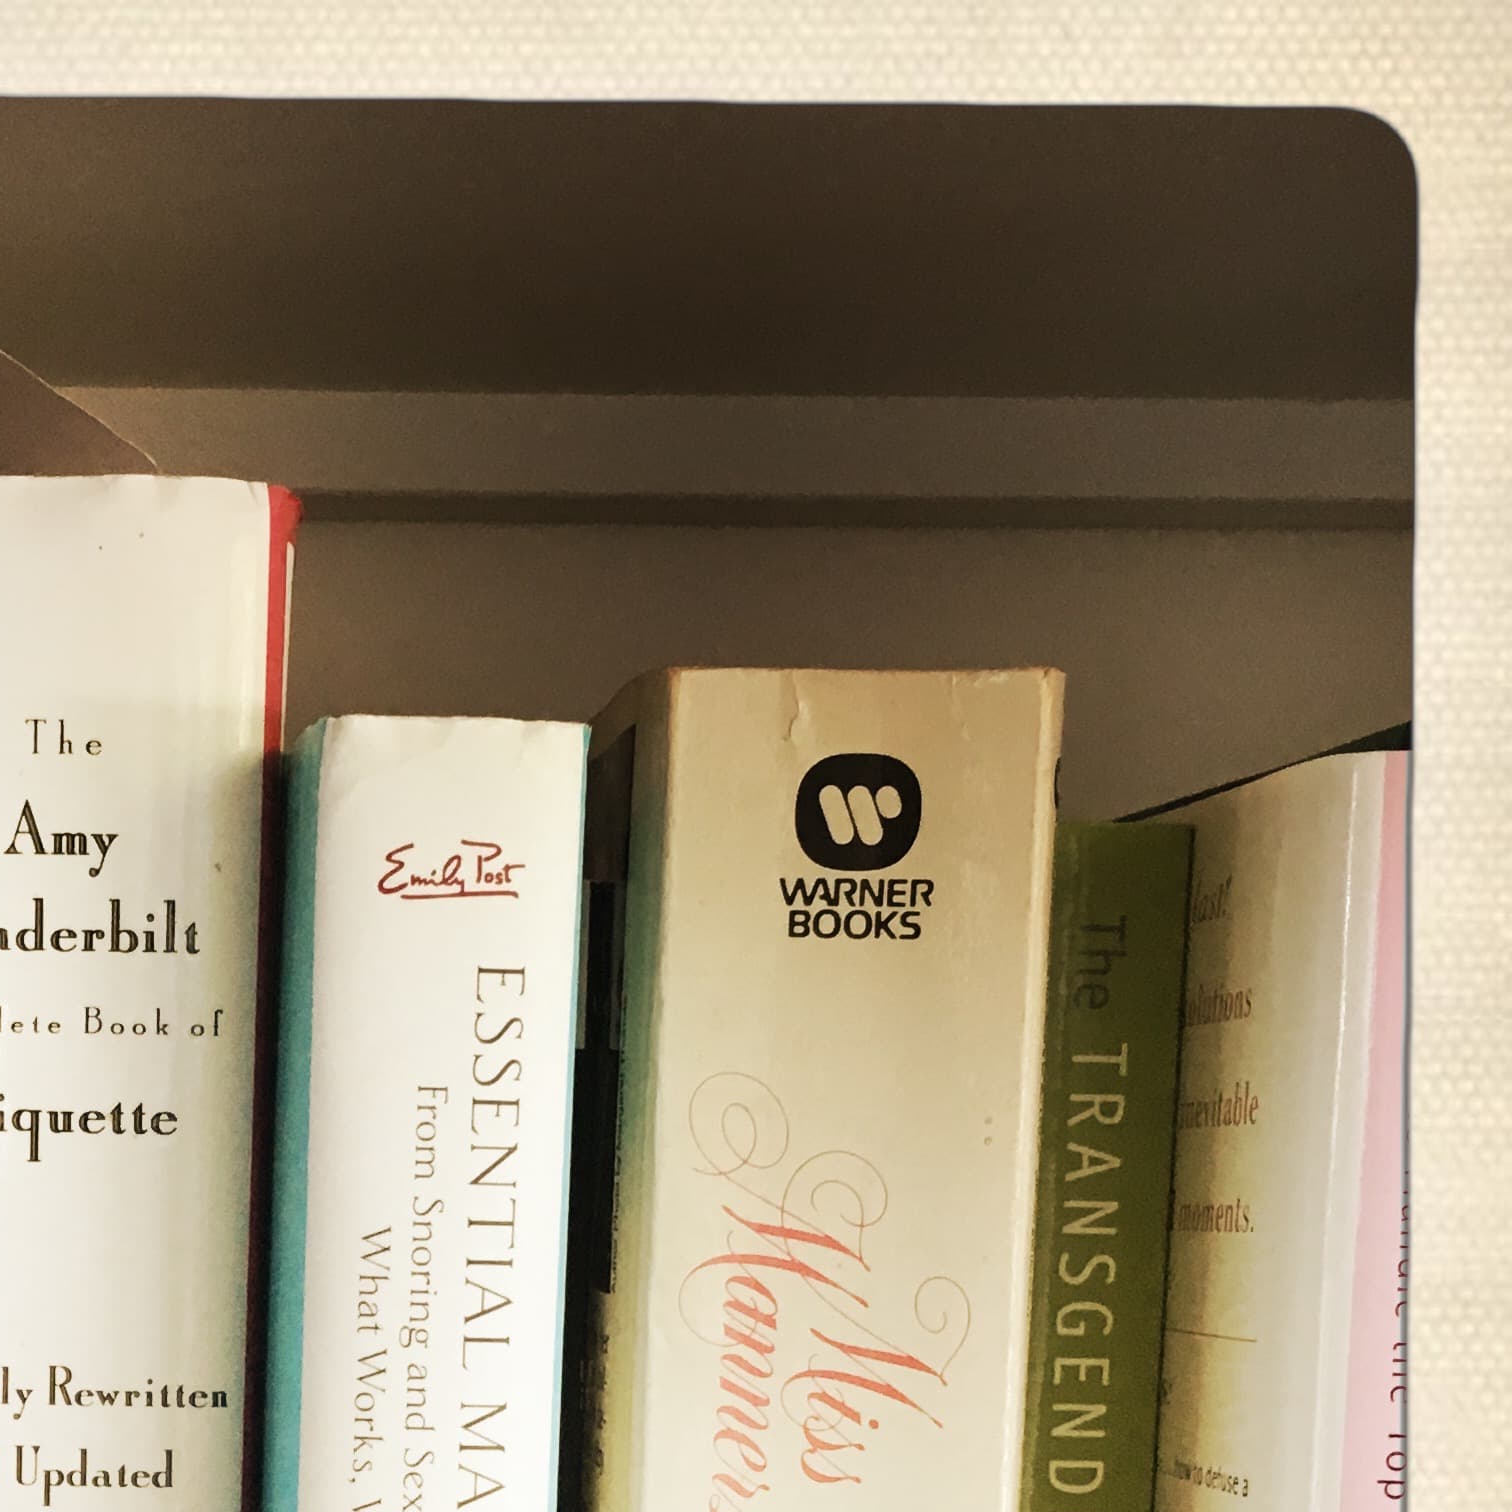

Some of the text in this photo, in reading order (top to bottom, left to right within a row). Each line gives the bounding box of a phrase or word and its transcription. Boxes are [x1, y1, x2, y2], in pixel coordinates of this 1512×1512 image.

[24, 718, 104, 757] The
[3, 799, 119, 879] Amy
[377, 838, 526, 896] Emily Post
[778, 877, 935, 908] WARNER
[787, 909, 922, 940] BOOKS
[1072, 914, 1128, 1012] The
[83, 1006, 170, 1037] Book
[189, 1008, 225, 1038] of
[413, 1084, 450, 1181] From
[462, 965, 527, 1371] ESSENTIAL
[356, 1226, 393, 1336] What
[397, 1195, 445, 1349] Snoring
[47, 1364, 229, 1409] Rewritten
[348, 1348, 388, 1483] Works,
[403, 1363, 436, 1432] and
[14, 1444, 174, 1507] Updated
[401, 1447, 436, 1512] Sex
